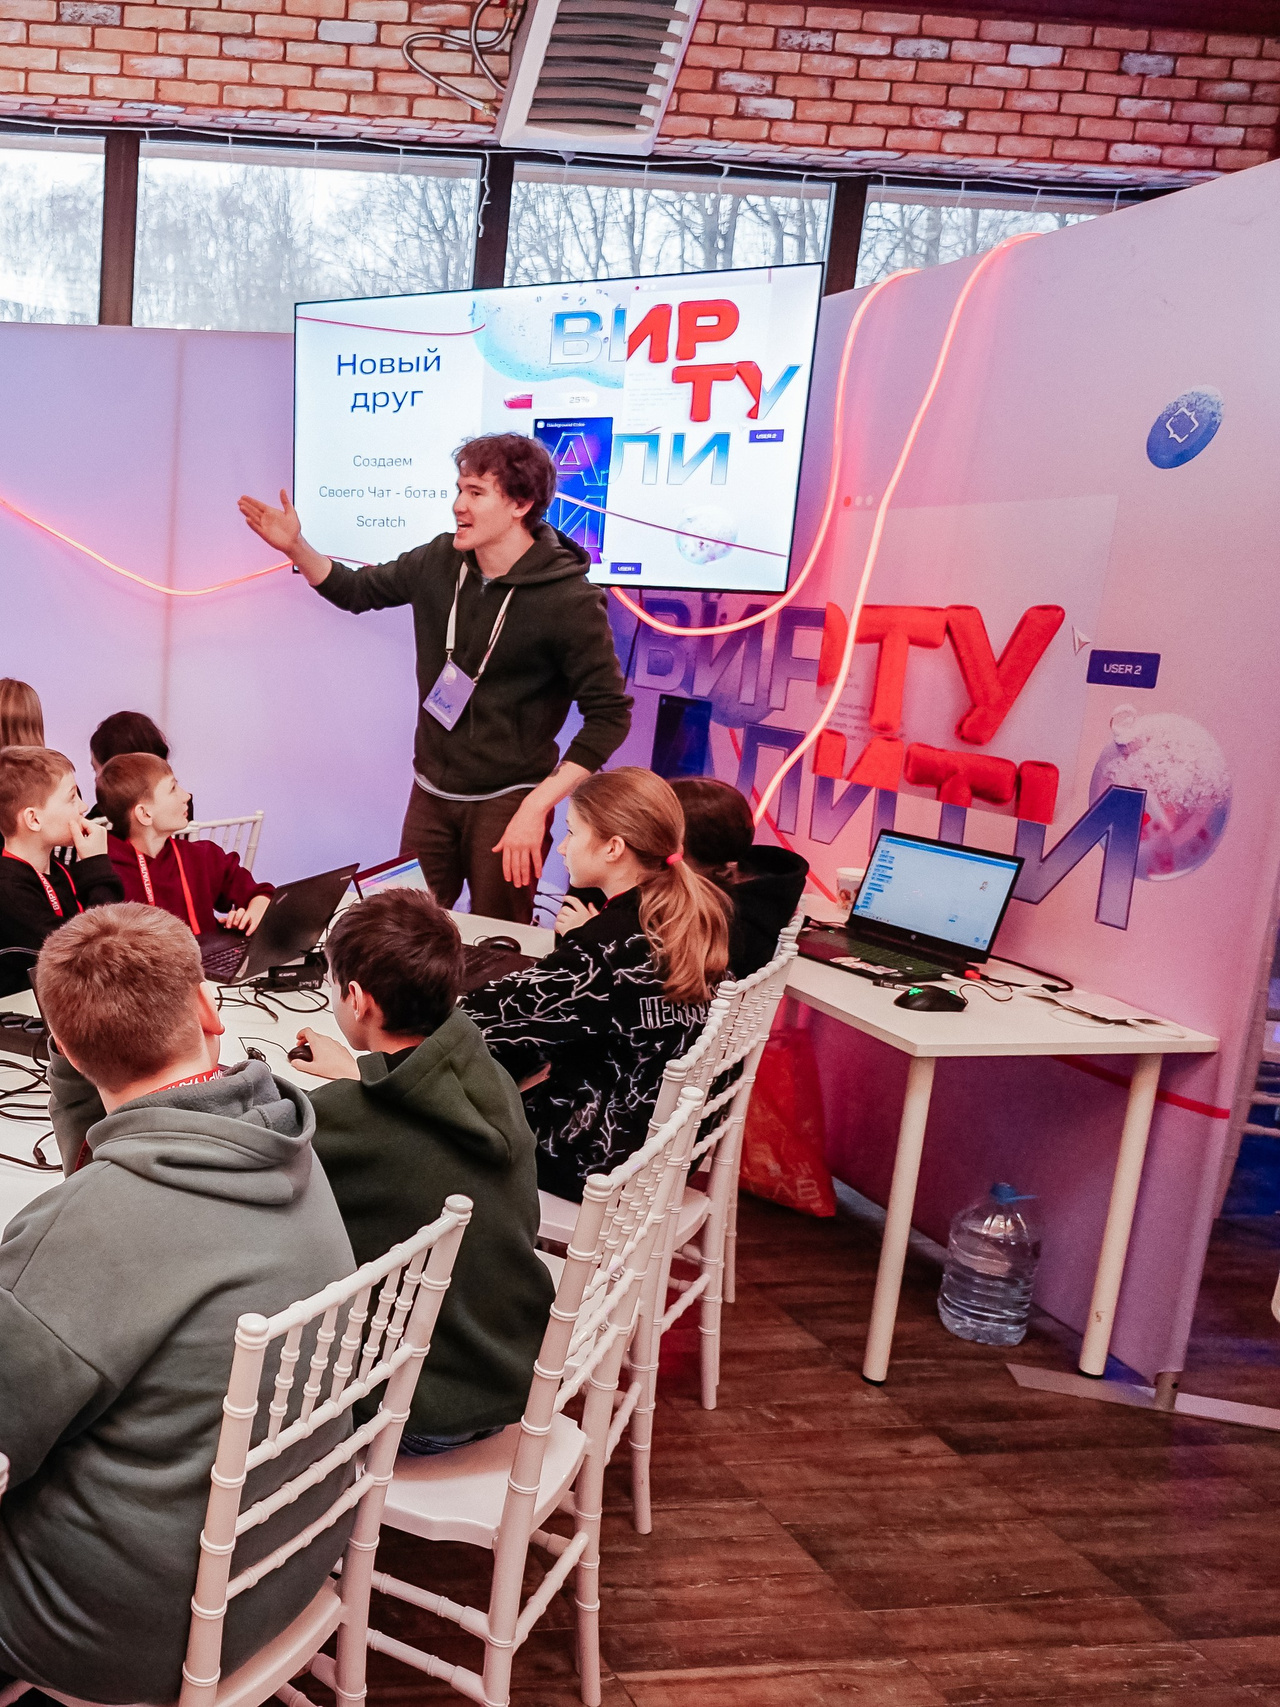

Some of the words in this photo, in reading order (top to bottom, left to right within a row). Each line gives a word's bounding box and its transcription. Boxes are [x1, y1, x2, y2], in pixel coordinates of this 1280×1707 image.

[337, 347, 441, 376] Новый
[350, 390, 424, 414] друг
[569, 396, 590, 404] 25%
[352, 455, 412, 468] Создаем
[319, 486, 365, 498] Своего
[367, 486, 391, 498] Чат
[404, 486, 436, 498] бота
[440, 489, 448, 498] в
[356, 515, 406, 528] Scratch
[1103, 663, 1133, 674] USER
[1133, 665, 1142, 675] 2
